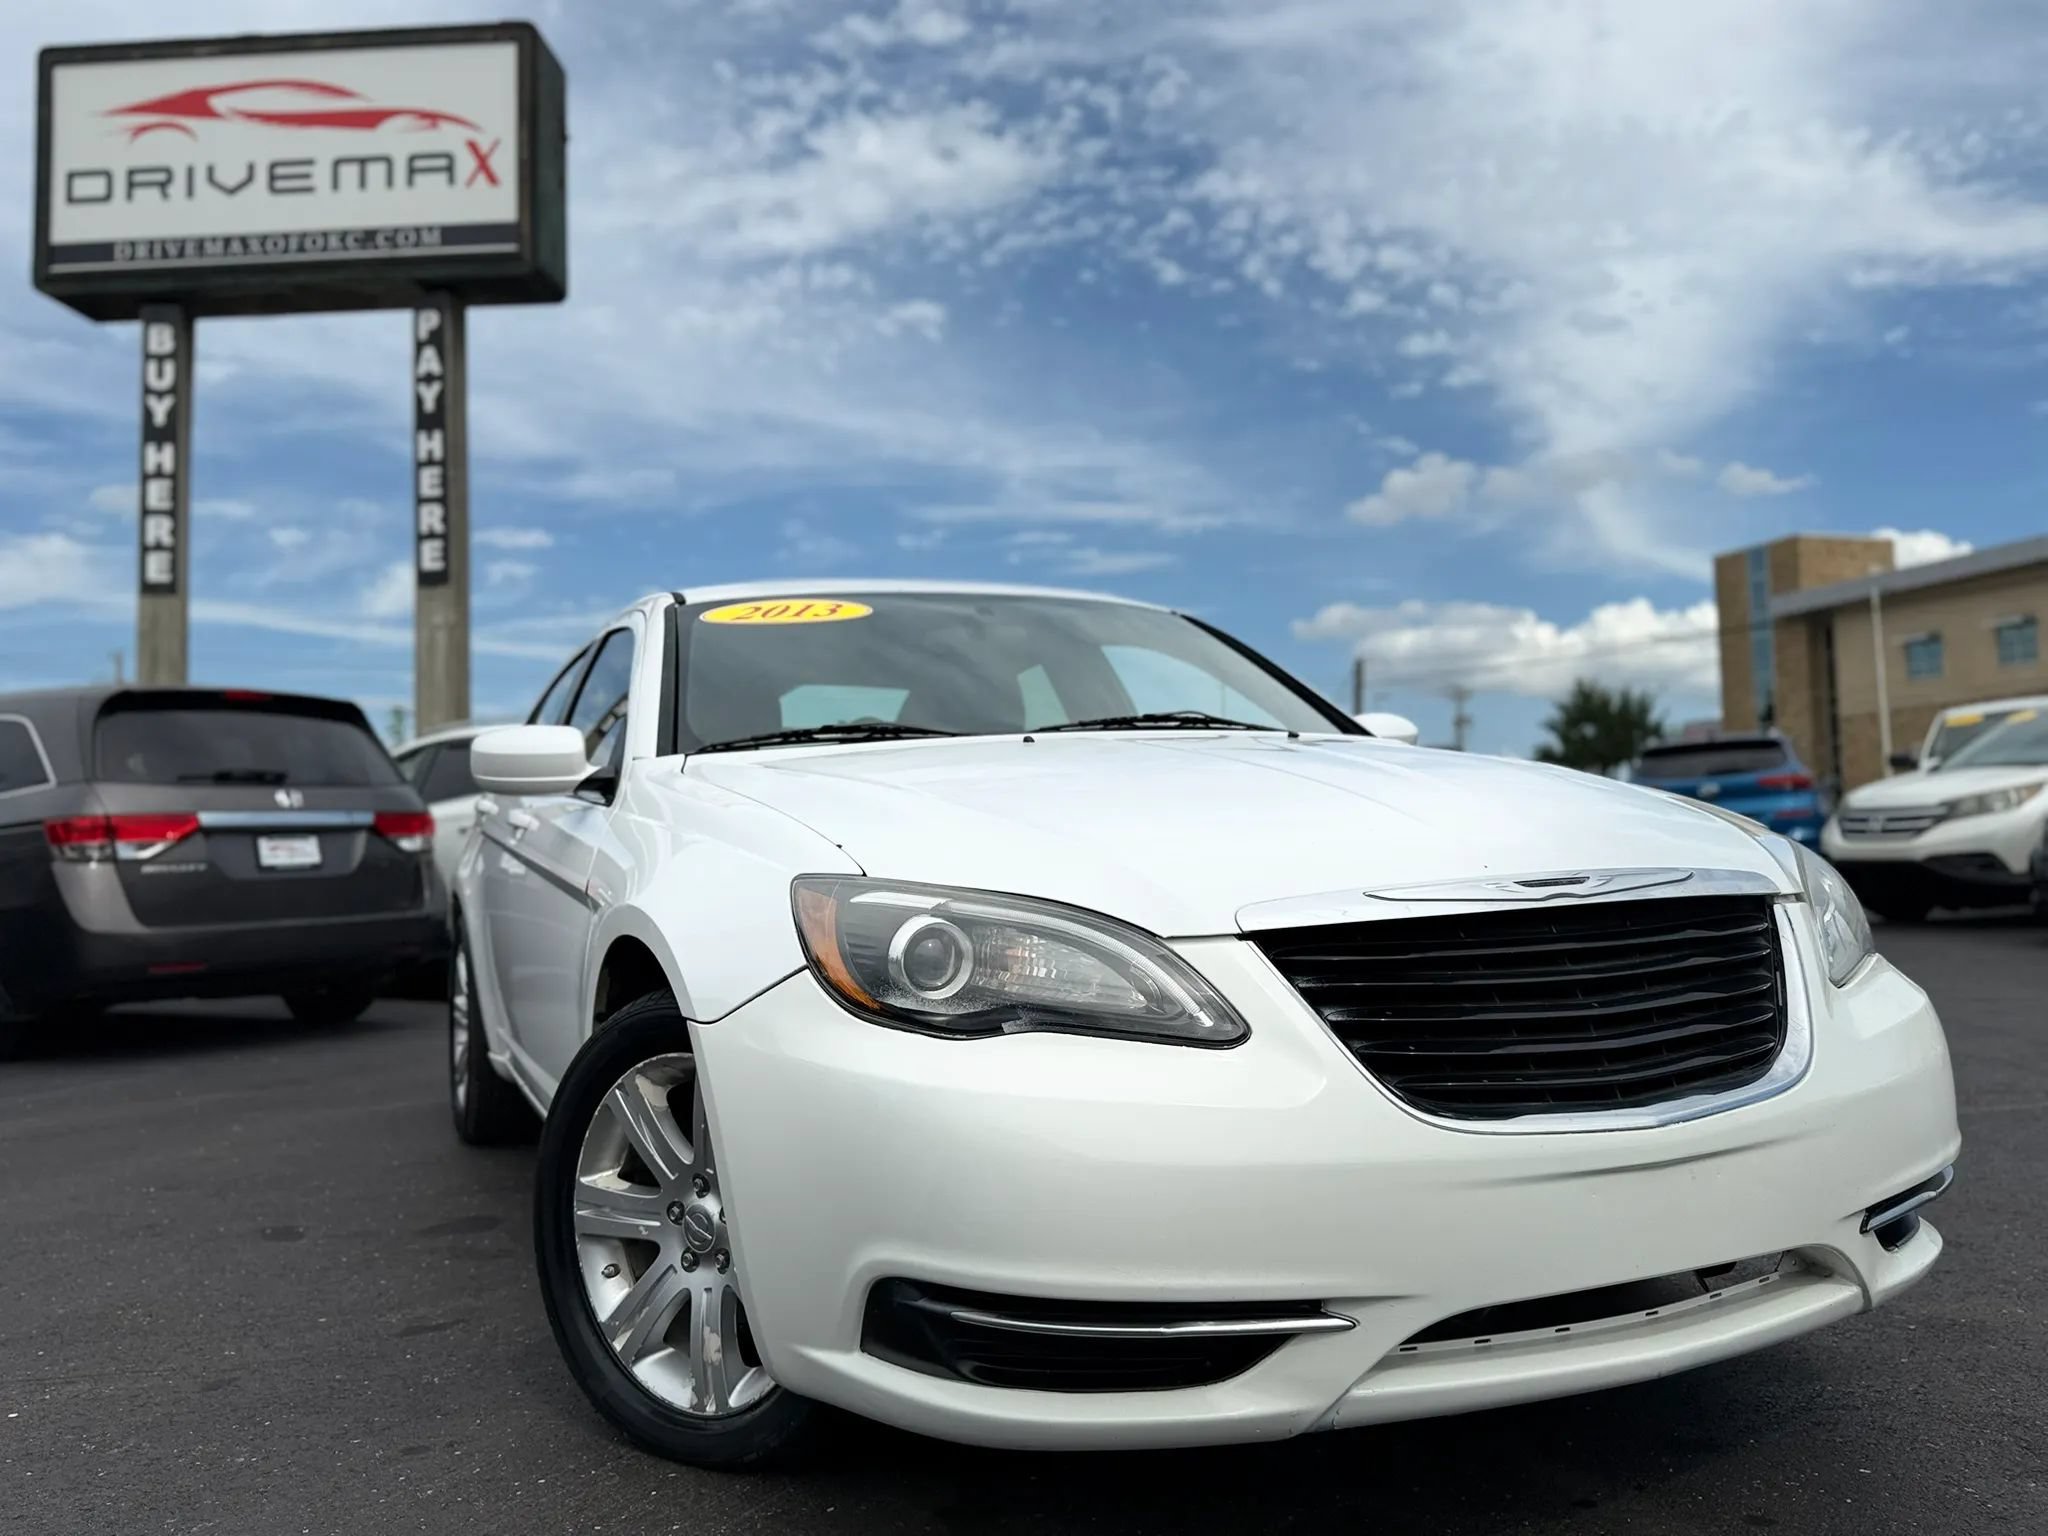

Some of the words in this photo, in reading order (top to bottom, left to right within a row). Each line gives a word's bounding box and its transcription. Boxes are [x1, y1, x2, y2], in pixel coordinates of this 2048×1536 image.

[66, 138, 500, 205] DRIVEMAX
[113, 226, 443, 262] DRIVEMAXOFOKC.COM
[145, 321, 176, 428] BUY
[417, 308, 444, 414] PAY
[144, 441, 175, 585] HERE
[418, 429, 446, 573] HERE
[732, 604, 843, 620] 2013
